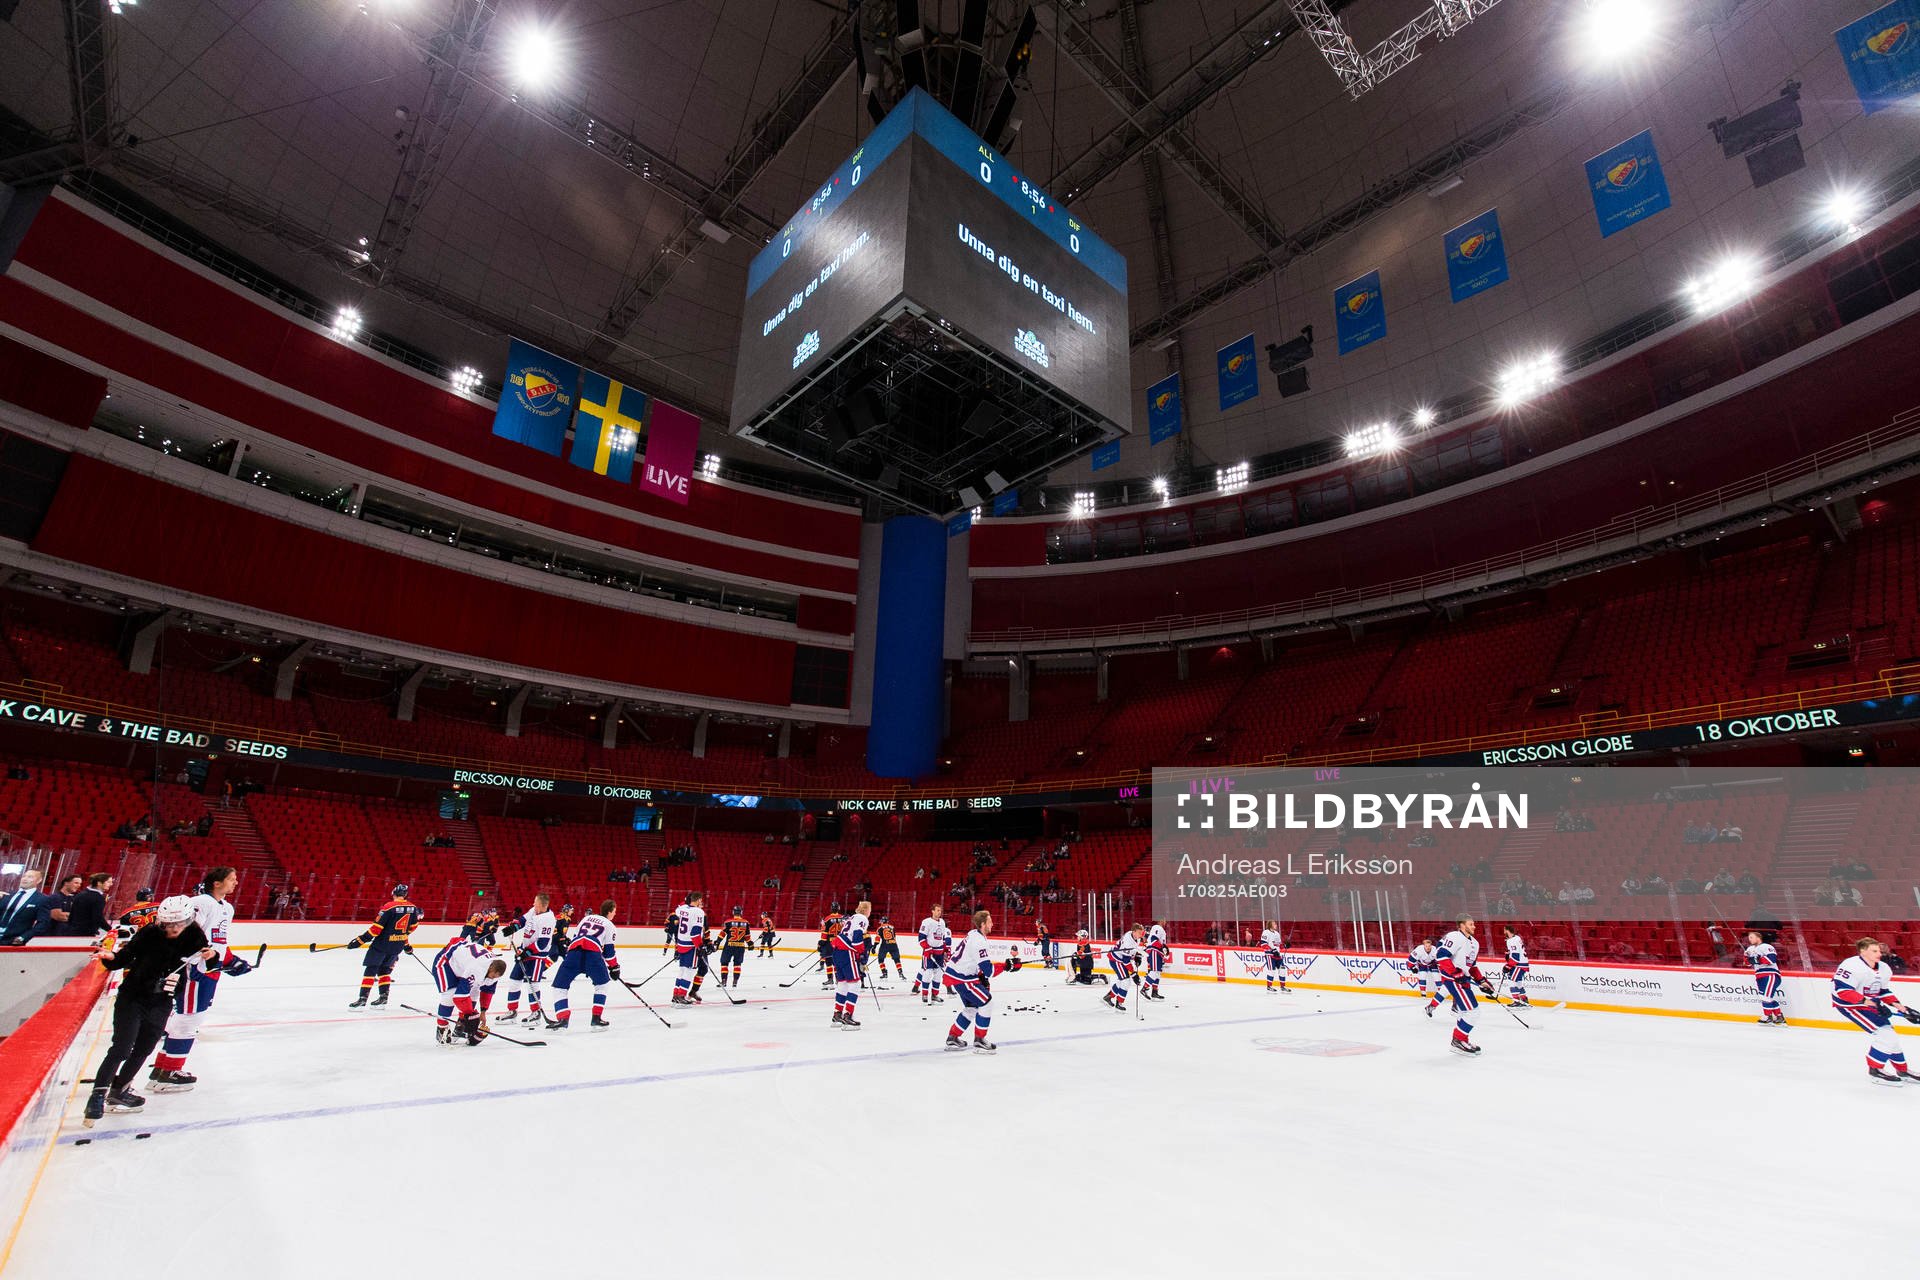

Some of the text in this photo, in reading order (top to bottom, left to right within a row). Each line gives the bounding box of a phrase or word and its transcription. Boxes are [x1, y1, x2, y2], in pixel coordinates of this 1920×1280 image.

[852, 148, 864, 165] DIF
[978, 145, 995, 163] ALL
[851, 165, 861, 186] 0
[980, 161, 992, 183] 0
[812, 186, 832, 213] 8:56
[1021, 181, 1046, 209] 8:56
[1031, 205, 1036, 215] 1
[1069, 218, 1081, 232] DIF
[782, 239, 791, 257] 0
[1070, 234, 1080, 254] 0
[958, 223, 1096, 335] Unna dig en taxi hem.
[763, 307, 786, 336] Unna
[788, 291, 803, 314] dig
[805, 278, 818, 299] en
[820, 255, 840, 284] taxi
[648, 465, 688, 494] LIVE
[22, 704, 88, 729] CAVE
[97, 718, 112, 733] &
[120, 721, 162, 741] THE
[165, 729, 210, 748] BAD
[224, 738, 288, 759] SEEDS
[1696, 708, 1841, 743] 18 OKTOBER
[1483, 735, 1634, 766] ERICSSON GLOBE
[453, 770, 554, 792] ERICSSON GLOBE
[1315, 768, 1341, 782] LIVE
[588, 784, 652, 800] 18 OKTOBER
[1119, 786, 1140, 798] LIVE
[1190, 776, 1236, 794] LIVE
[837, 797, 1002, 811] NICK CAVE & THE BAD SEEDS
[394, 913, 410, 933] 4
[541, 927, 552, 935] 20
[577, 922, 605, 939] 67
[729, 927, 746, 942] 37
[1444, 939, 1453, 947] 10
[1350, 971, 1372, 981] print
[1836, 968, 1851, 979] 25
[1600, 977, 1661, 989] Stockholm
